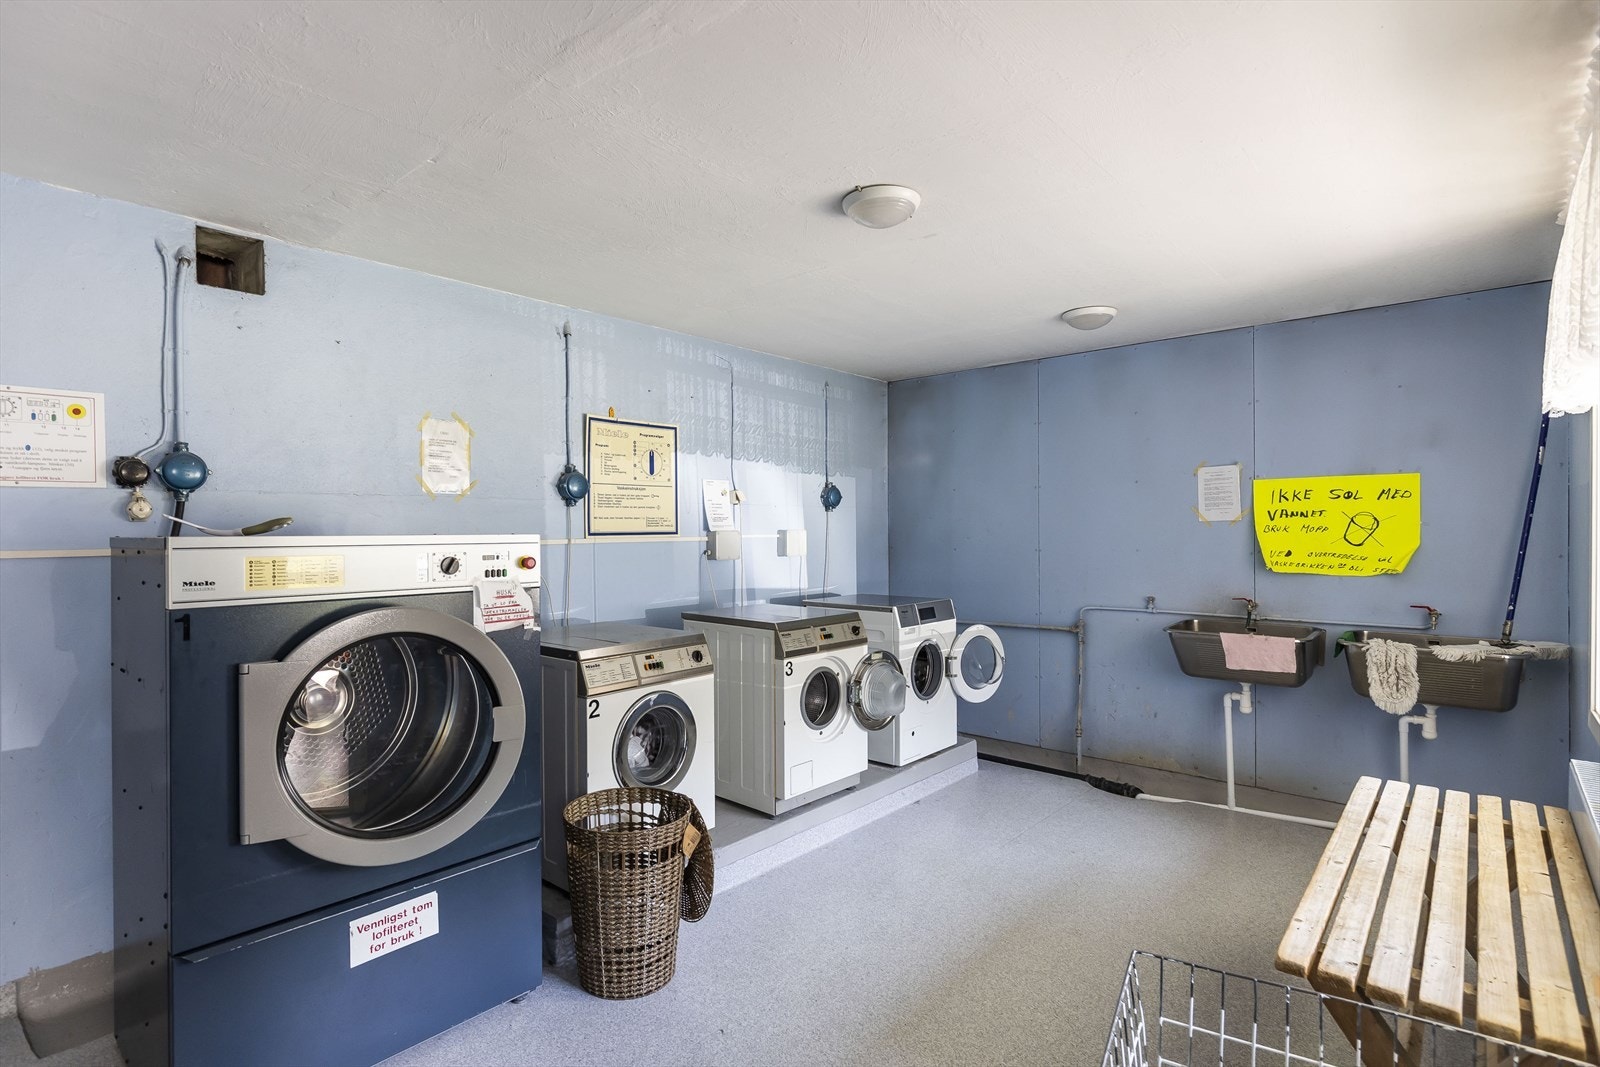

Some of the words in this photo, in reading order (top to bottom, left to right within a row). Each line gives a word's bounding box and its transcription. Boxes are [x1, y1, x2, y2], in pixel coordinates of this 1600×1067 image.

[1271, 488, 1314, 504] IKKE
[1377, 488, 1412, 500] MED
[1263, 525, 1290, 533] BRUK
[1301, 524, 1329, 533] MOPP
[174, 613, 191, 641] 1
[785, 661, 793, 676] 3
[588, 699, 600, 719] 2
[356, 909, 407, 934] Vennligst
[372, 917, 418, 941] lofilteret
[391, 930, 415, 945] bruk
